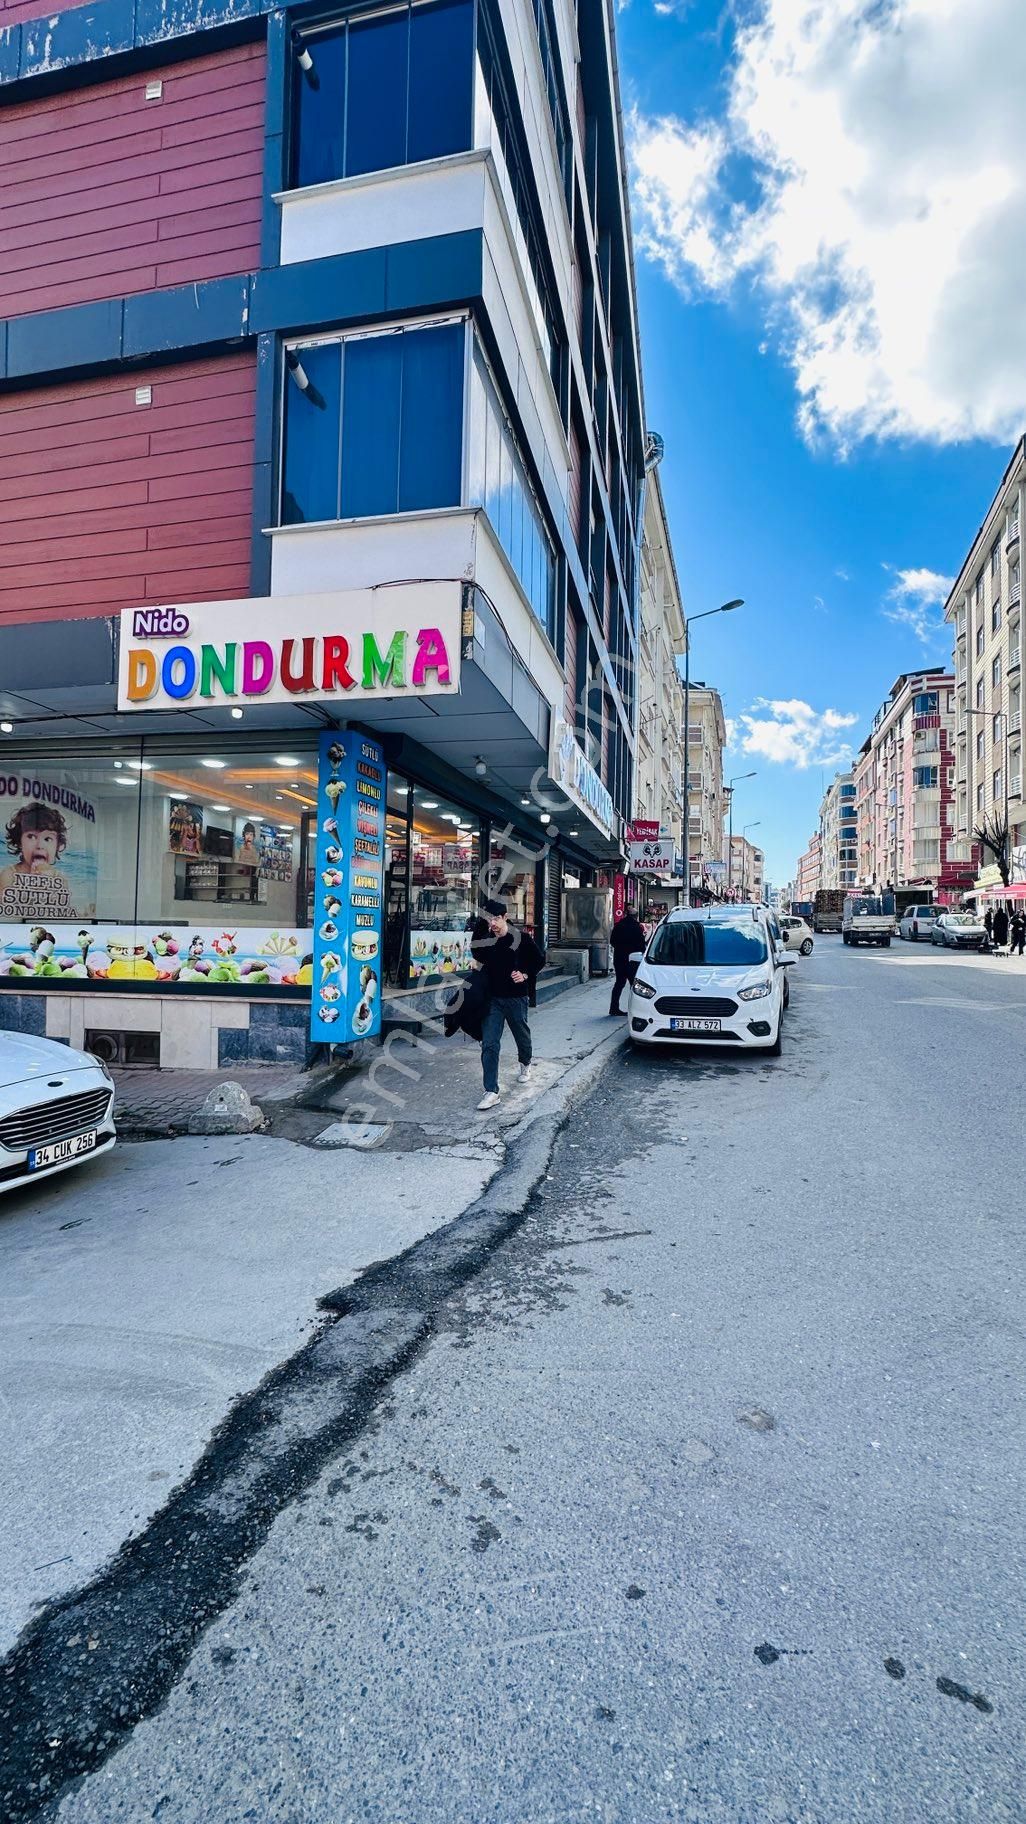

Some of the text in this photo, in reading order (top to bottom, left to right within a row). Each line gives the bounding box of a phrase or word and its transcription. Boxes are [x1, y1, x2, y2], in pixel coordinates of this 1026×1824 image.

[133, 609, 190, 637] Nido
[127, 629, 452, 702] DONDURMA
[361, 744, 379, 762] SÜTLÜ
[356, 780, 381, 800] LİMONLU
[23, 778, 96, 824] DONDURMA
[634, 859, 669, 869] KASAP
[354, 874, 378, 890] KAVUNLU
[3, 885, 70, 907] SÜTLÜ
[355, 914, 375, 927] MUZLU
[674, 1020, 719, 1030] 33 ALZ 572
[35, 1149, 50, 1166] 34
[53, 1140, 73, 1160] CUK
[76, 1133, 93, 1152] 256
